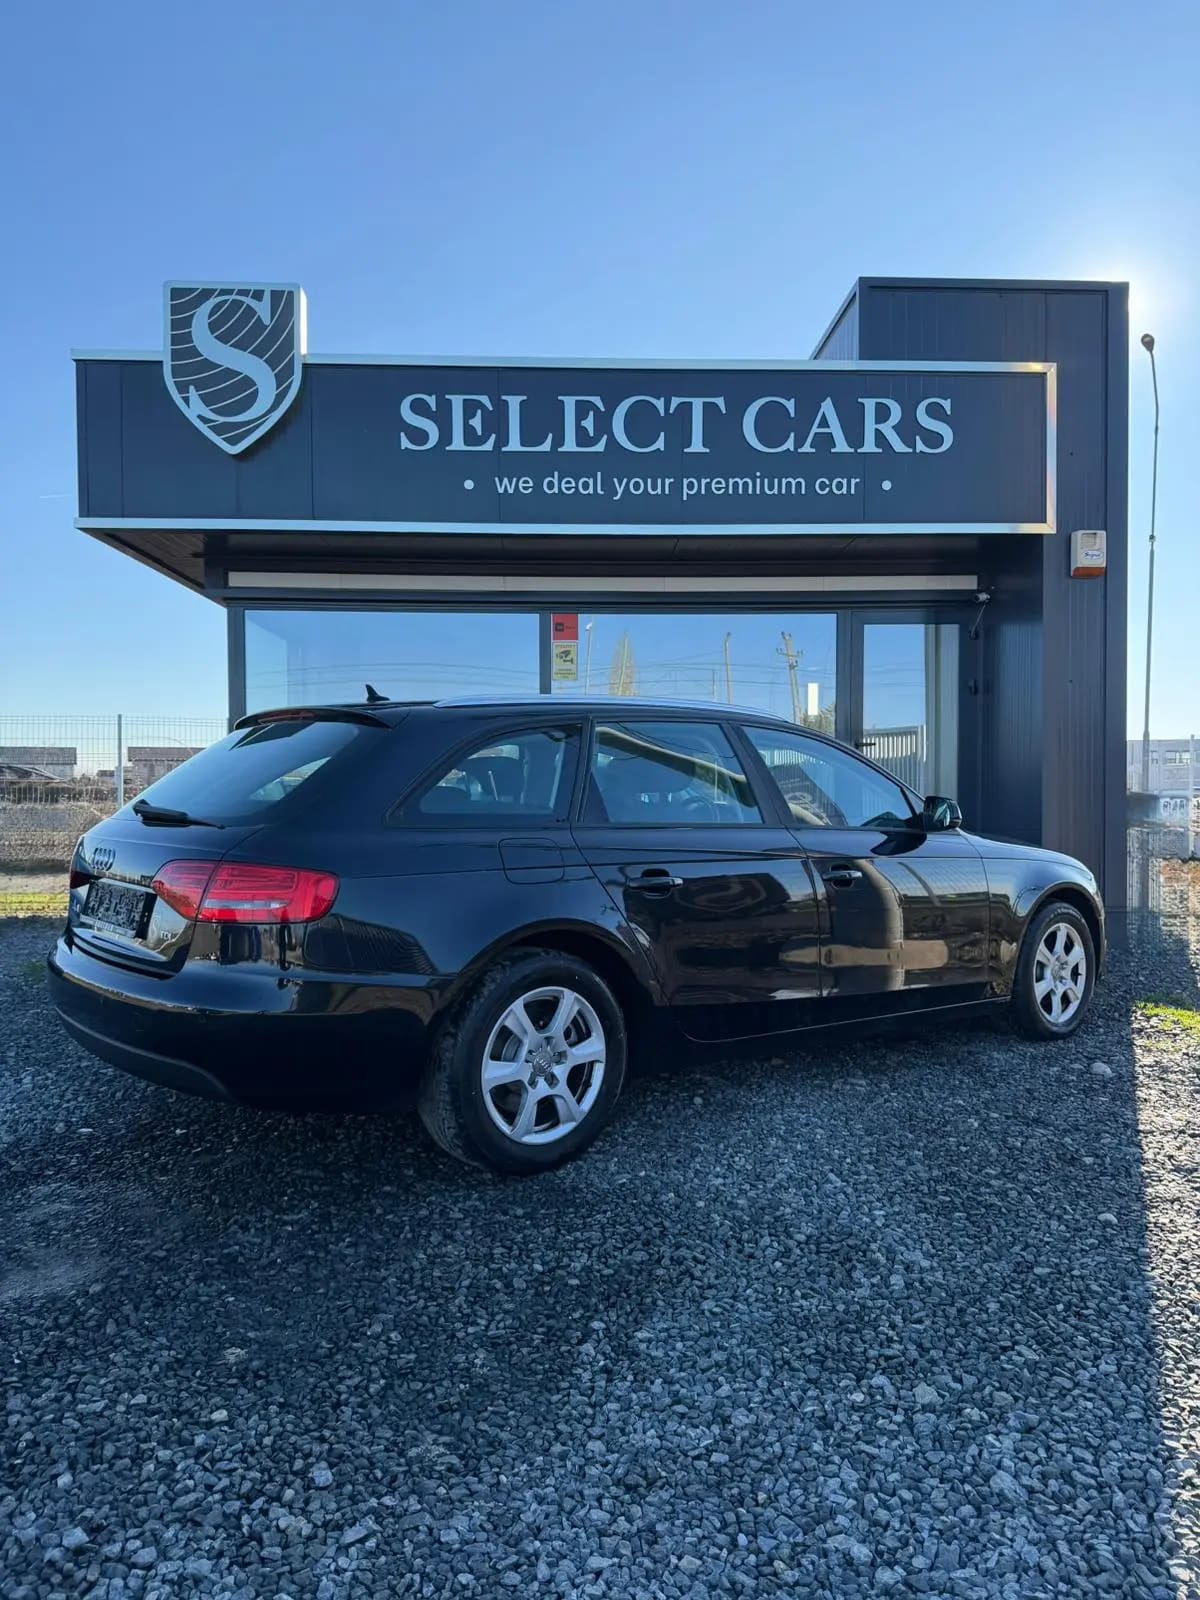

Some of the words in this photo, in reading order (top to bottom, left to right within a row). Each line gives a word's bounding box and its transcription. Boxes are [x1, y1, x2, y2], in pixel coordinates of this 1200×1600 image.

[190, 288, 277, 422] S
[400, 393, 727, 453] SELECT
[742, 396, 955, 454] CARS
[494, 476, 534, 494] we
[542, 471, 605, 495] deal
[612, 476, 675, 501] your
[682, 471, 806, 501] premium
[814, 476, 861, 495] car
